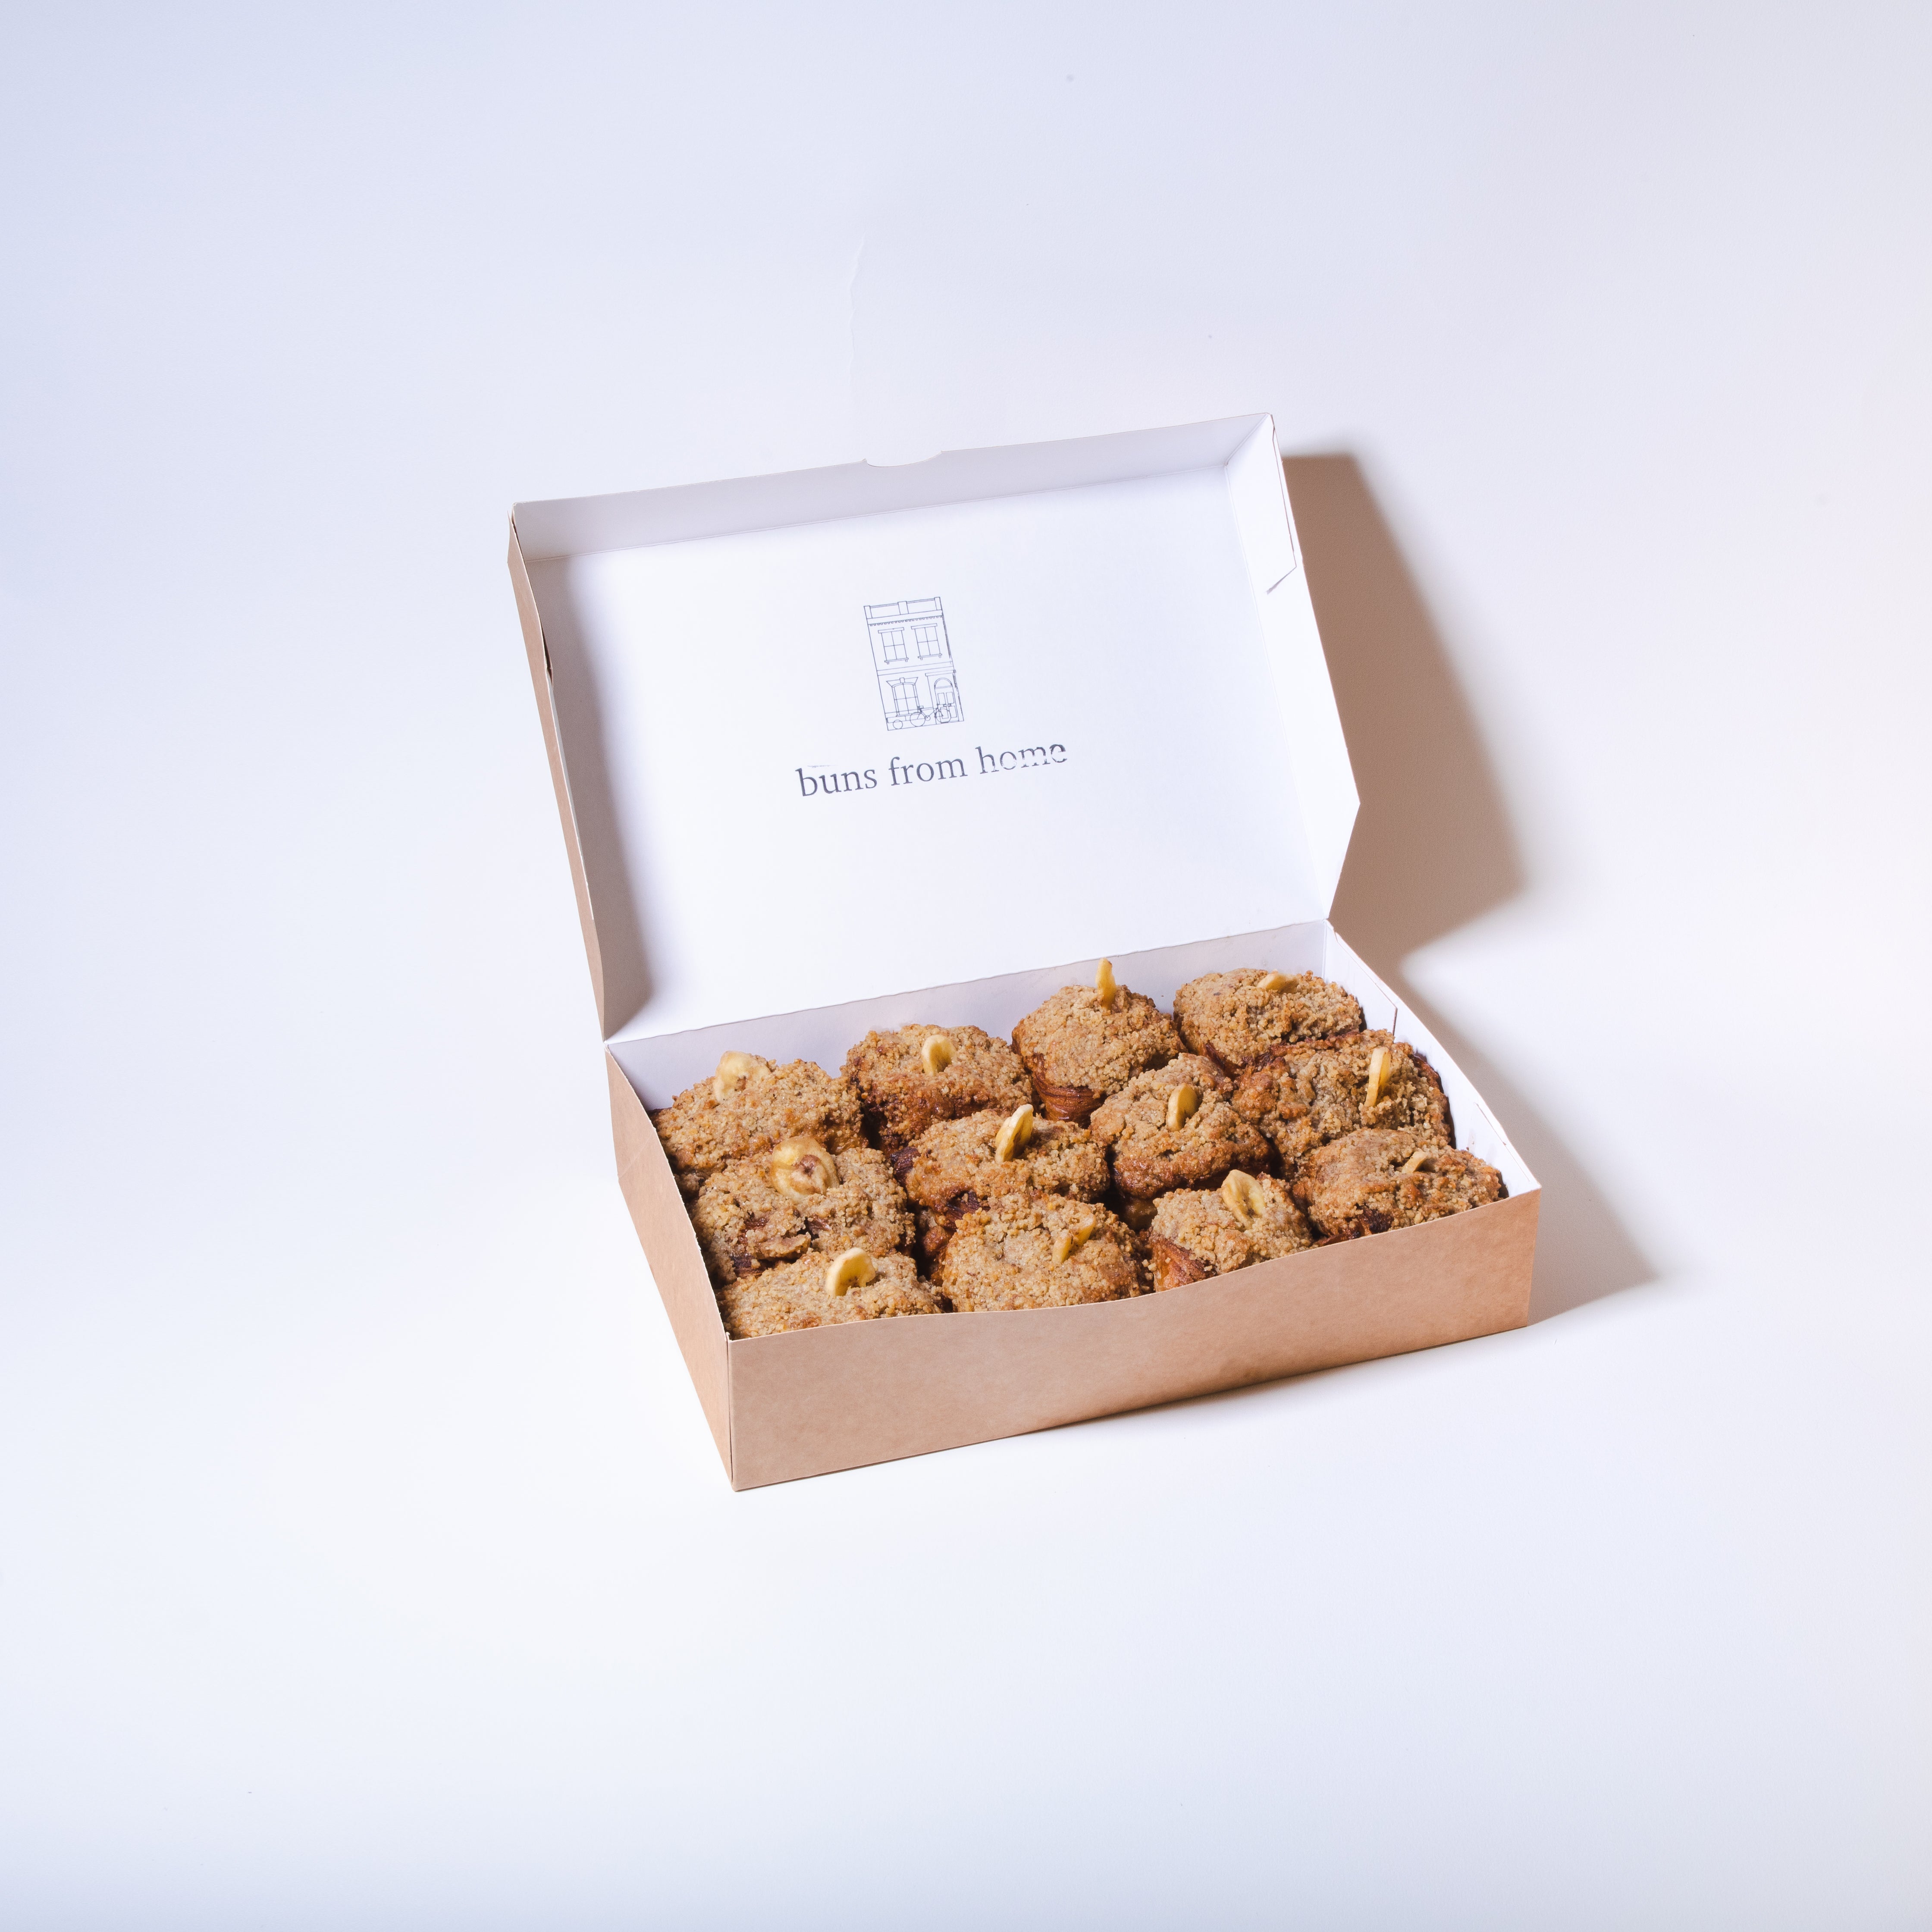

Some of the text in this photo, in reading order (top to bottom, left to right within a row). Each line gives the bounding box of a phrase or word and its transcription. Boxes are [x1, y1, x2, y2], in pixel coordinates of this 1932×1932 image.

[795, 744, 1068, 797] buns from home
